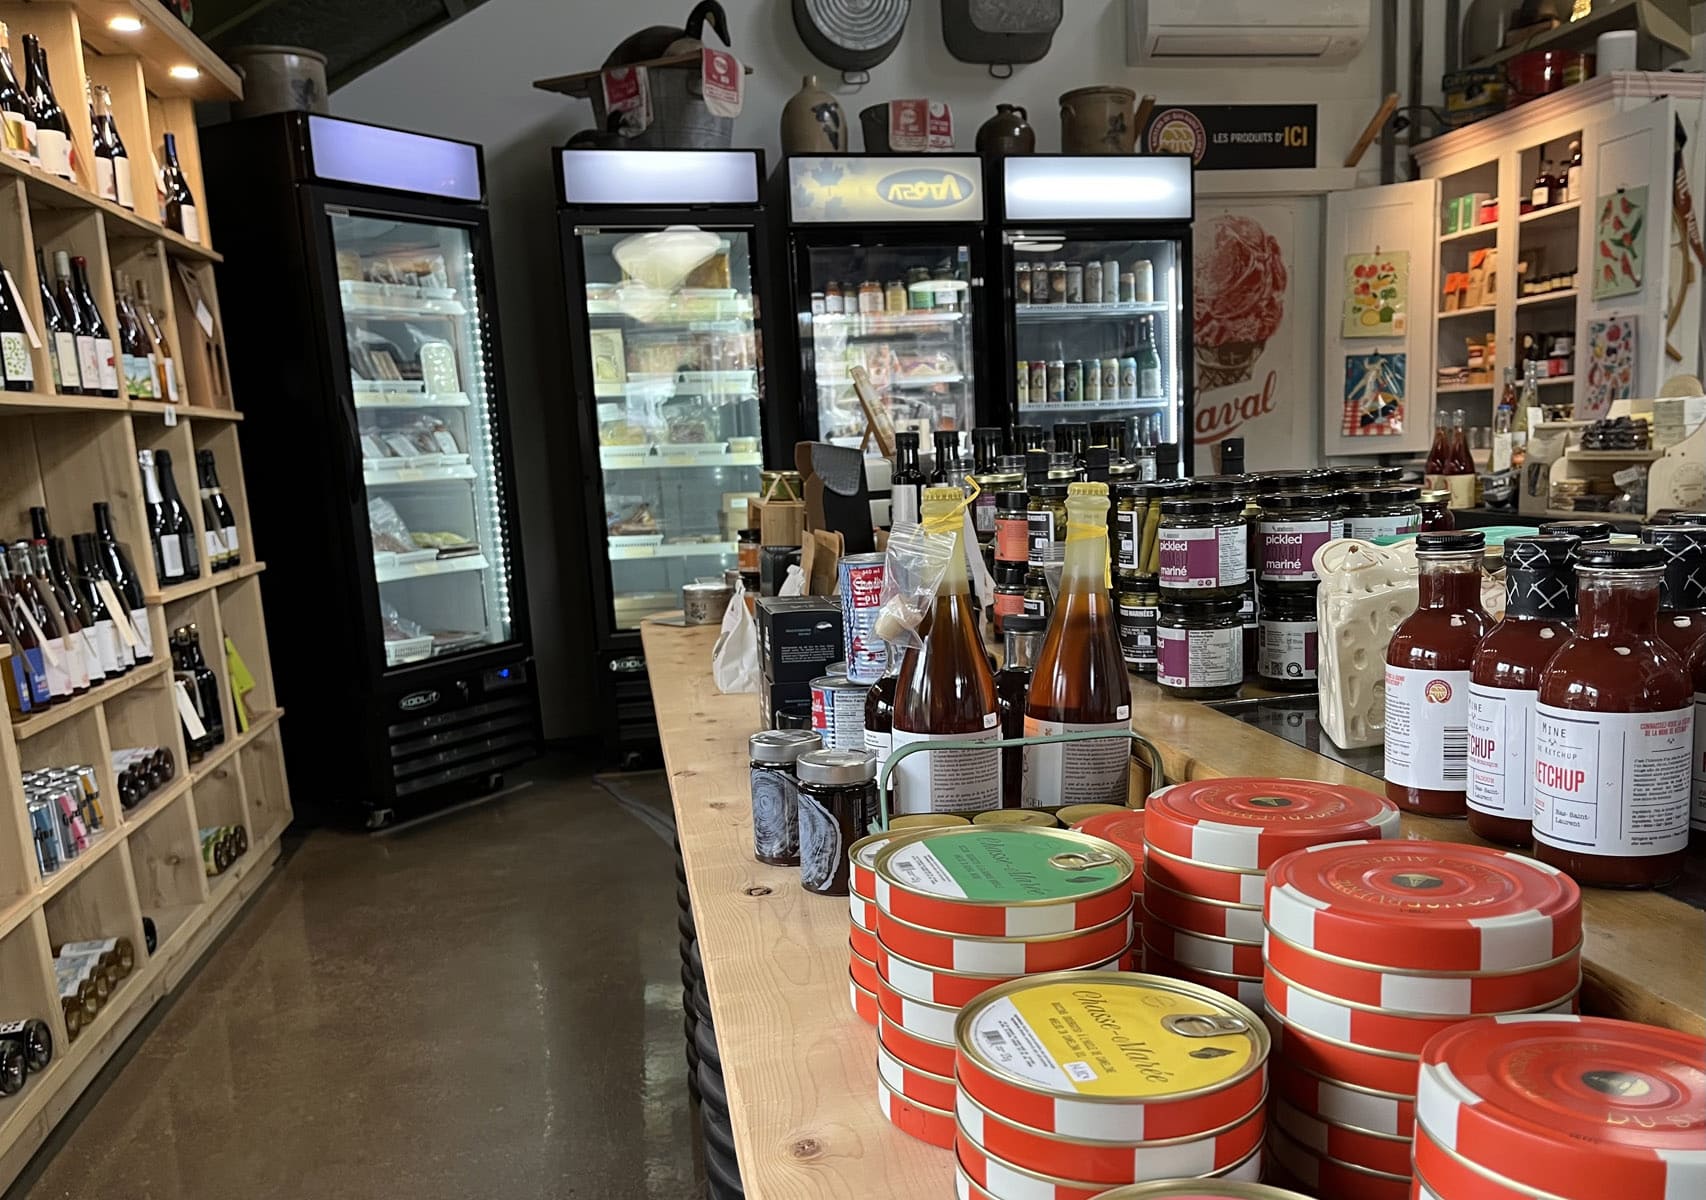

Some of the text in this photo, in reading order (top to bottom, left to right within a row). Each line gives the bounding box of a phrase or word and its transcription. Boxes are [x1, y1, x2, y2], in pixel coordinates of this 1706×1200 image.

[1213, 132, 1229, 144] LES
[1230, 131, 1273, 144] PRODUITS
[1159, 540, 1188, 552] pickled
[1265, 533, 1303, 546] pickled
[1160, 564, 1188, 576] mariné
[1266, 558, 1302, 569] mariné
[864, 594, 879, 606] PU
[1541, 721, 1568, 738] MINE
[1468, 733, 1496, 760] TCHUP
[1544, 746, 1577, 761] KETCHUP
[1555, 817, 1581, 829] Laurent
[1071, 989, 1175, 1084] Chasse-Marée
